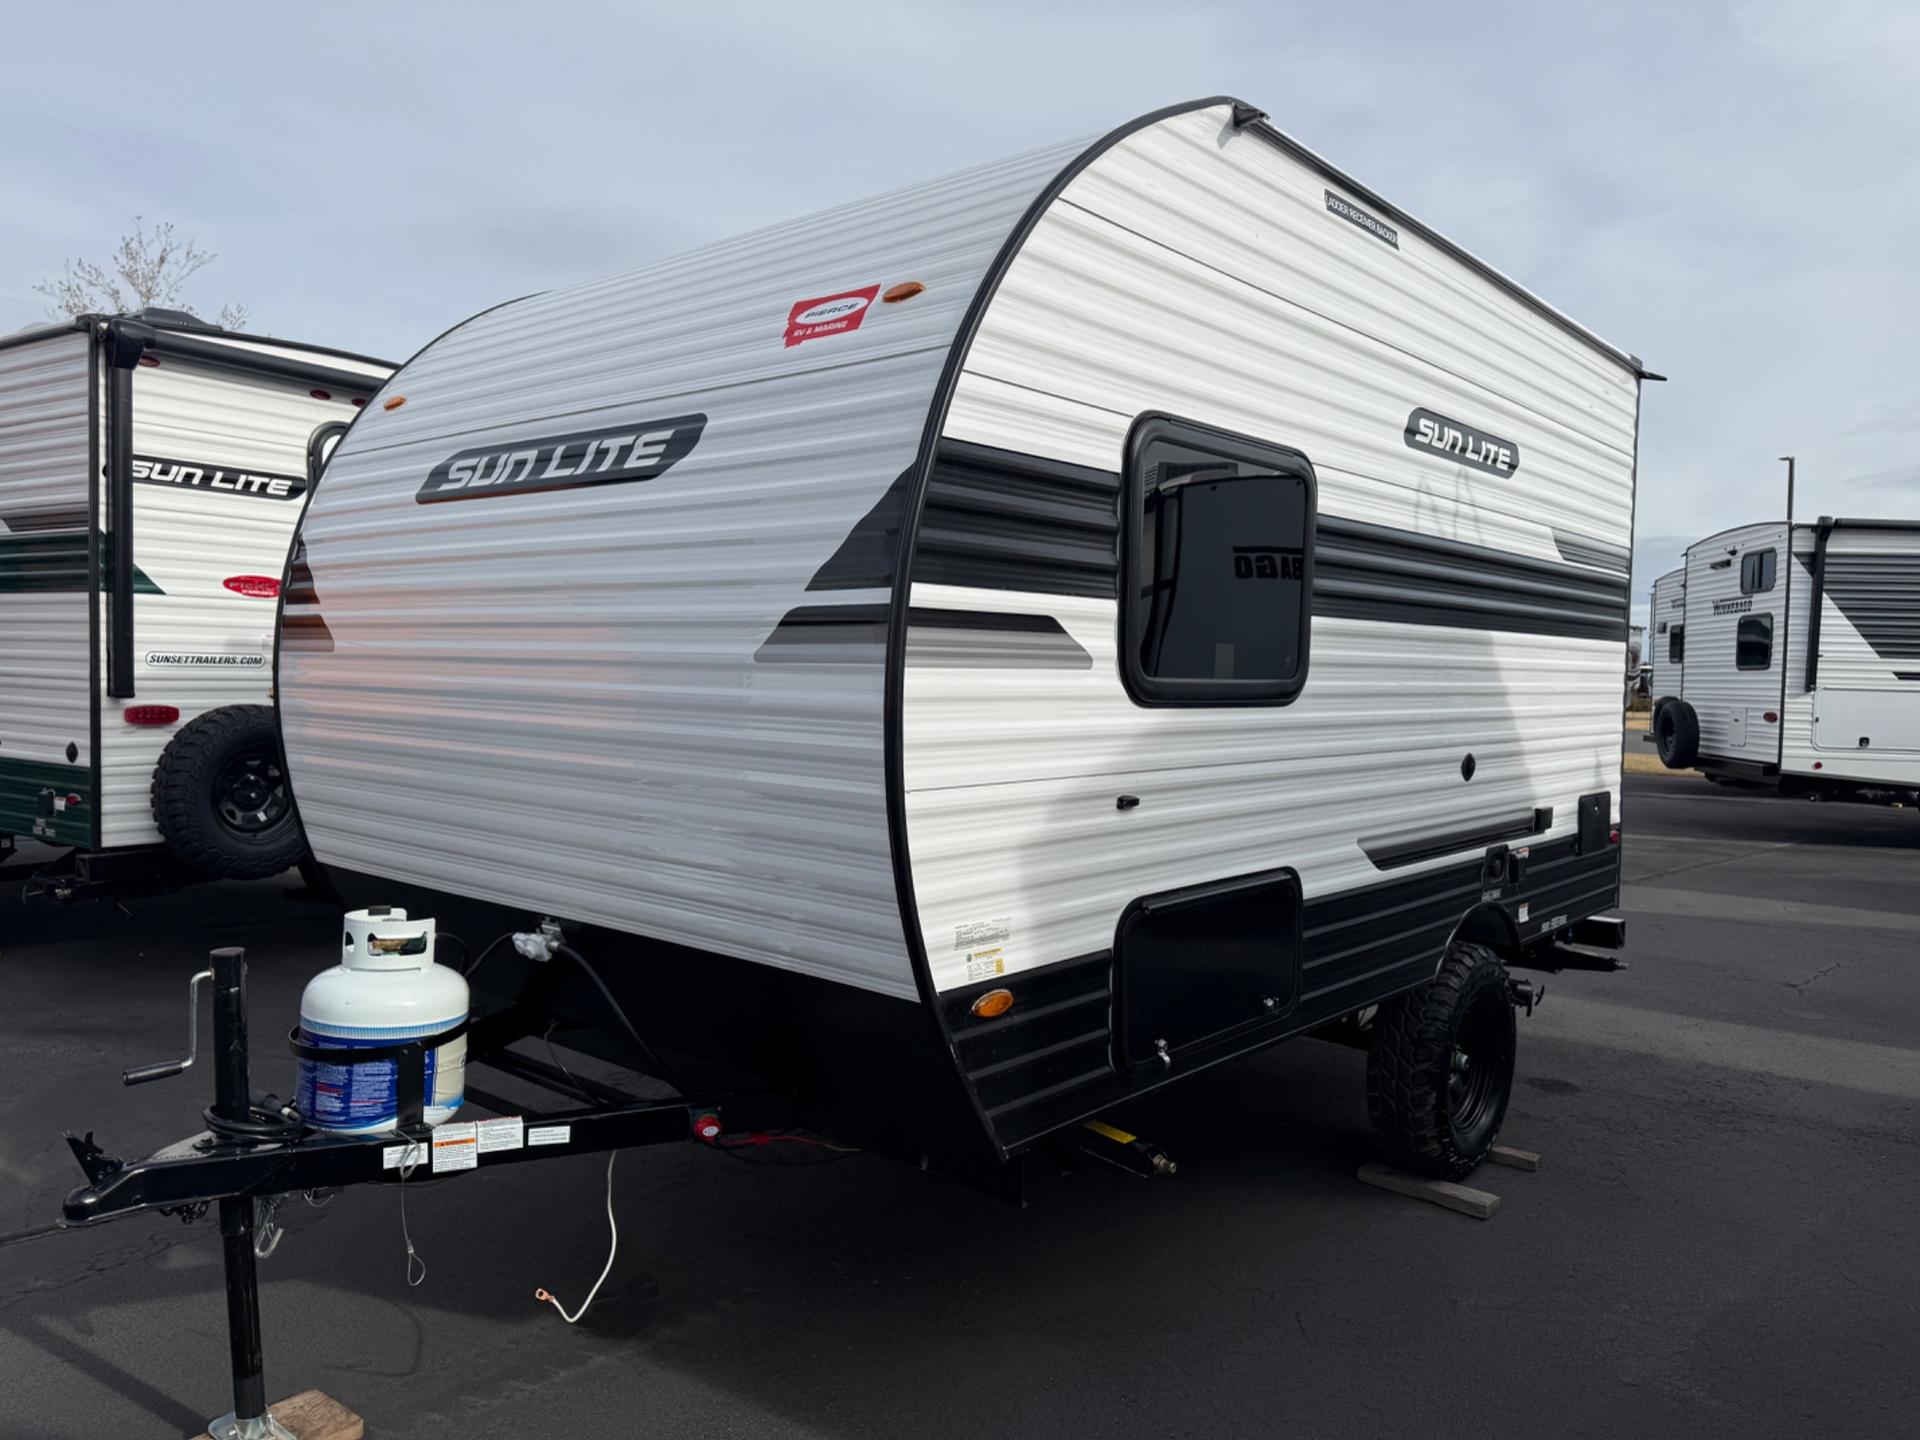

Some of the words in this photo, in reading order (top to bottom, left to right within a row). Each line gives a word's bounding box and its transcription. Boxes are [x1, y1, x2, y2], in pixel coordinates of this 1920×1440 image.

[1325, 194, 1349, 216] LADDER
[1349, 207, 1376, 231] RECEIVER
[1377, 223, 1398, 244] BACKER
[793, 328, 806, 337] RV
[814, 320, 848, 333] MARINE
[805, 302, 859, 319] PIERCE
[437, 450, 538, 491] SUN
[540, 429, 675, 479] LITE
[1415, 418, 1462, 454] SUN
[1465, 436, 1511, 471] LITE
[132, 460, 203, 484] SUN
[211, 471, 292, 496] LITE
[149, 654, 262, 665] SUNSETTRAILERS.COM
